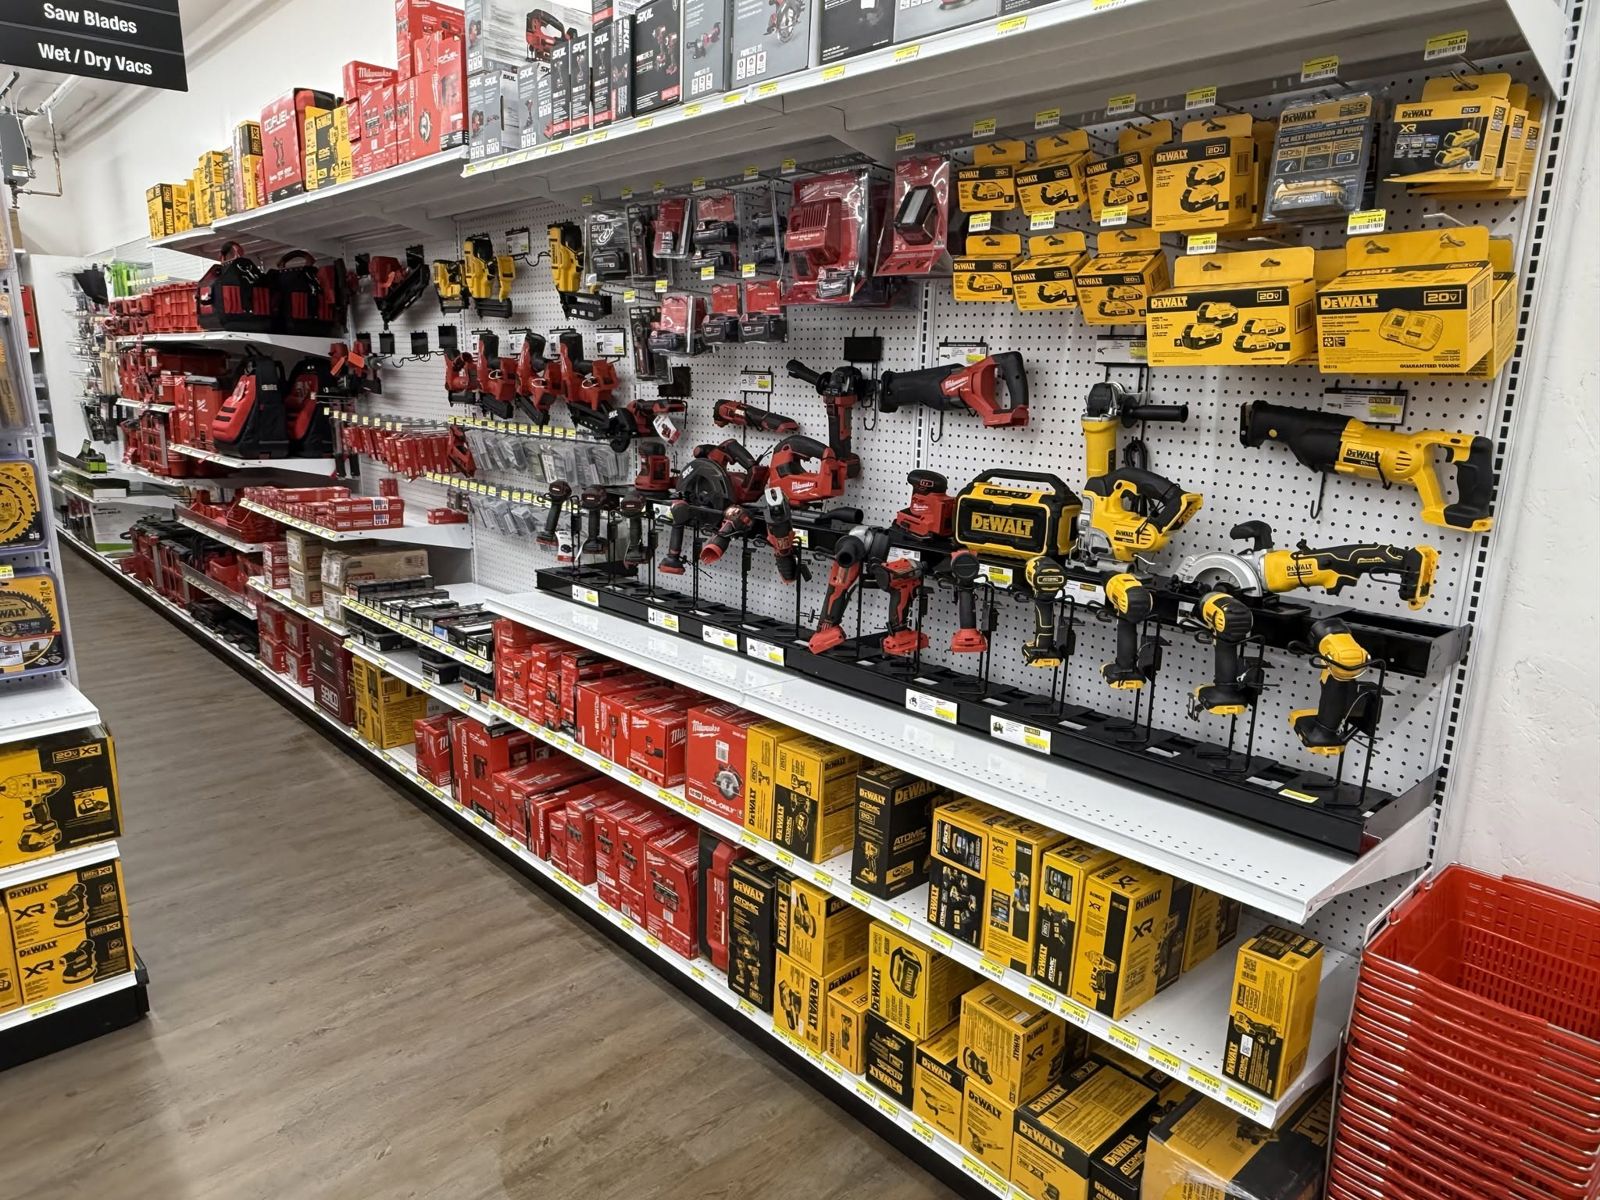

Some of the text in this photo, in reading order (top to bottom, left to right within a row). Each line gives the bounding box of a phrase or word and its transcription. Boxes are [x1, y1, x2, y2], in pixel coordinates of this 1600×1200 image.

[43, 2, 138, 34] Saw Blades
[637, 8, 654, 24] SKIL
[572, 40, 587, 53] SKIL
[594, 32, 609, 46] SKIL
[37, 42, 153, 75] Wet / Dry Vacs
[552, 47, 567, 60] SKIL
[469, 76, 482, 88] SKIL
[484, 75, 498, 87] SKIL
[502, 73, 517, 82] SKIL
[519, 66, 534, 80] SKIL
[1400, 124, 1418, 133] XR
[1156, 150, 1189, 162] DEWALT
[959, 170, 980, 179] DEWALT
[1016, 174, 1039, 185] DEWALT
[954, 261, 976, 270] DEWALT
[1014, 273, 1036, 282] DEWALT
[1077, 277, 1103, 285] DEWALT
[1151, 292, 1279, 309] DEWALT 20V
[1321, 292, 1457, 310] DEWALT 20V
[1346, 448, 1379, 461] DEWAL
[971, 514, 1033, 538] DEWALT
[320, 684, 339, 708] SENCO
[692, 719, 721, 733] Milwaukee
[55, 745, 98, 760] 20V XR
[825, 757, 846, 771] DEWALT
[748, 787, 757, 826] DEWALT
[859, 788, 886, 806] DEWALT
[859, 801, 881, 815] ATOMIC
[776, 803, 785, 841] DEWALT
[893, 827, 927, 846] ATOMIC
[9, 882, 49, 900] DEWALT
[733, 878, 765, 903] DEWALT
[1112, 875, 1138, 889] XR
[733, 895, 759, 915] ATOMIC
[930, 884, 940, 923] DEWALT
[1088, 901, 1103, 912] XR
[1135, 889, 1162, 912] DEWALT
[14, 903, 47, 922] XR
[778, 897, 789, 947] DEWALT
[939, 903, 948, 928] ATOMIC
[1132, 918, 1155, 943] XR
[19, 940, 58, 958] DEWALT
[23, 959, 55, 979] XR
[1037, 943, 1048, 977] DEWALT
[1048, 956, 1057, 983] ATOMIC
[872, 965, 881, 1012] DEWALT
[807, 978, 819, 1031] DEWALT
[1026, 1022, 1049, 1042] DEWALT
[1013, 1034, 1021, 1061] DEWALT
[1026, 1044, 1044, 1067] XR
[1226, 1041, 1239, 1075] DEWALT
[921, 1056, 952, 1083] DEWALT
[870, 1064, 903, 1095] DEWALT
[968, 1089, 1002, 1120] DEWALT
[1029, 1084, 1068, 1113] DEWALT
[1018, 1121, 1065, 1159] DEWALT
[1101, 1135, 1143, 1167] DEWALT
